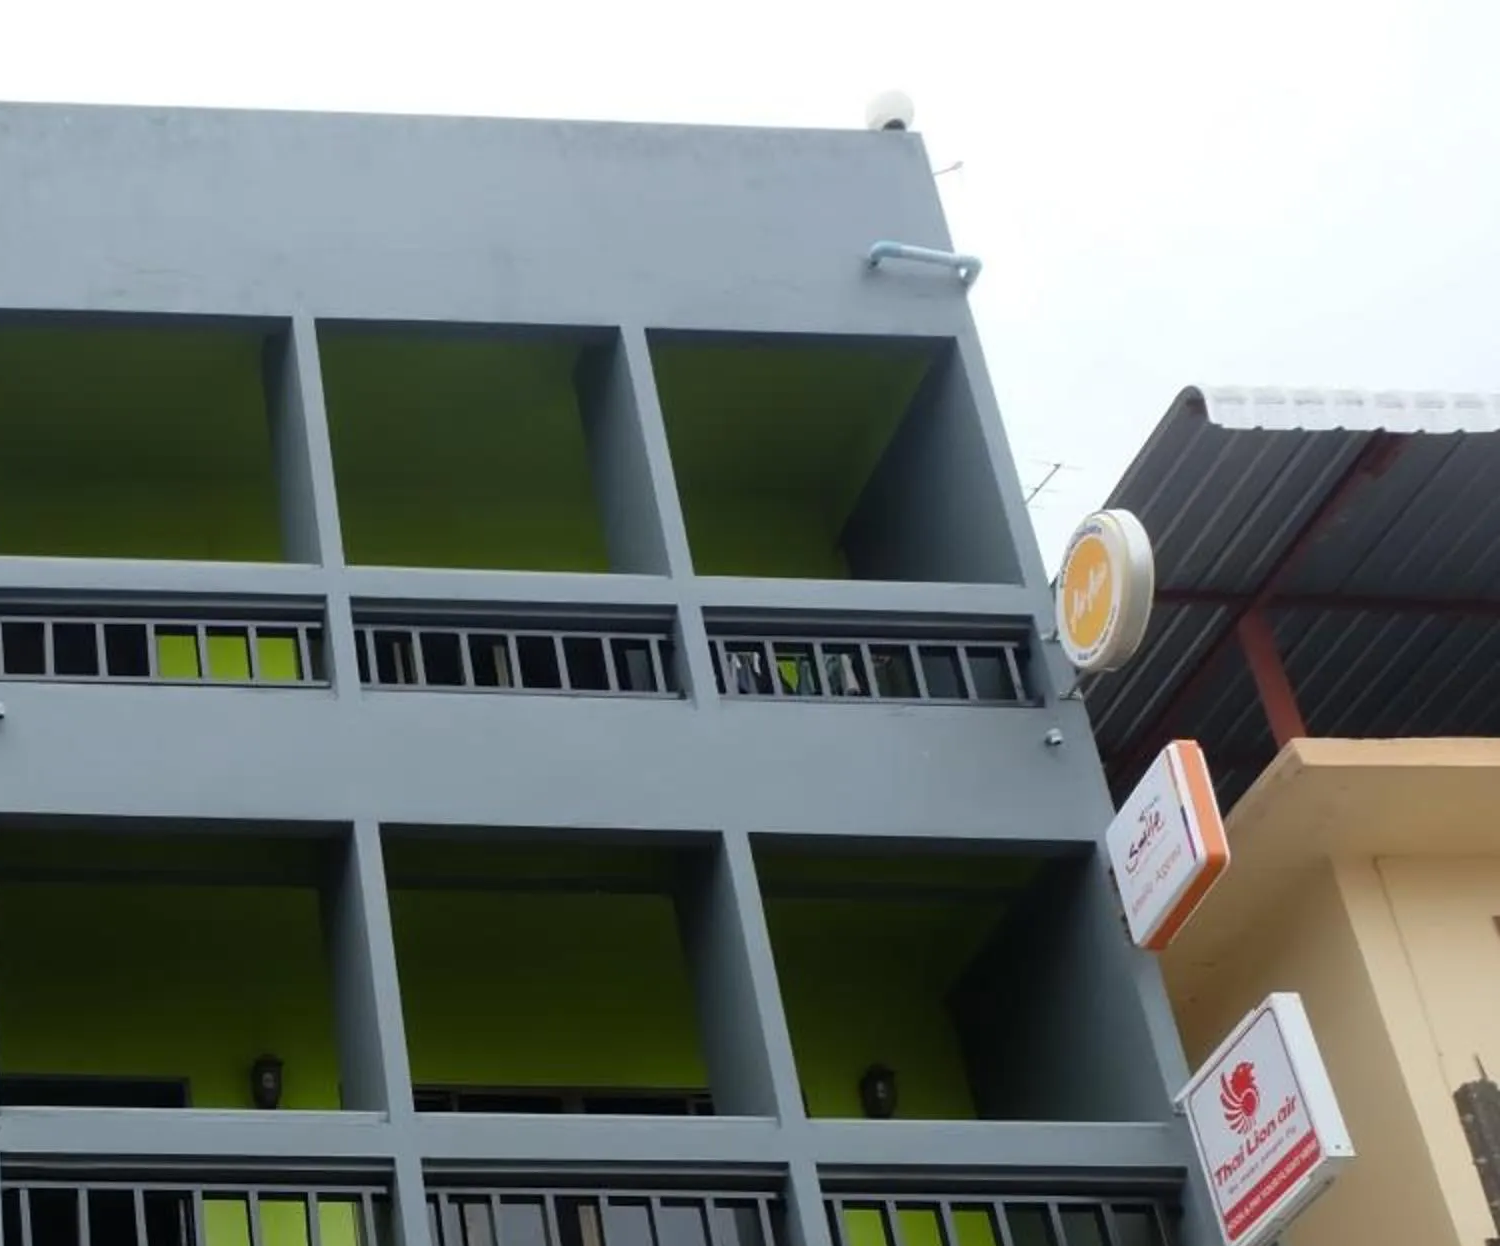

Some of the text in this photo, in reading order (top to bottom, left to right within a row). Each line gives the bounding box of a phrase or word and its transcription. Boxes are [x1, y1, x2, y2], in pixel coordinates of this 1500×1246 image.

[1214, 1144, 1245, 1186] Thai
[1245, 1119, 1277, 1156] Lion
[1276, 1095, 1297, 1123] air
